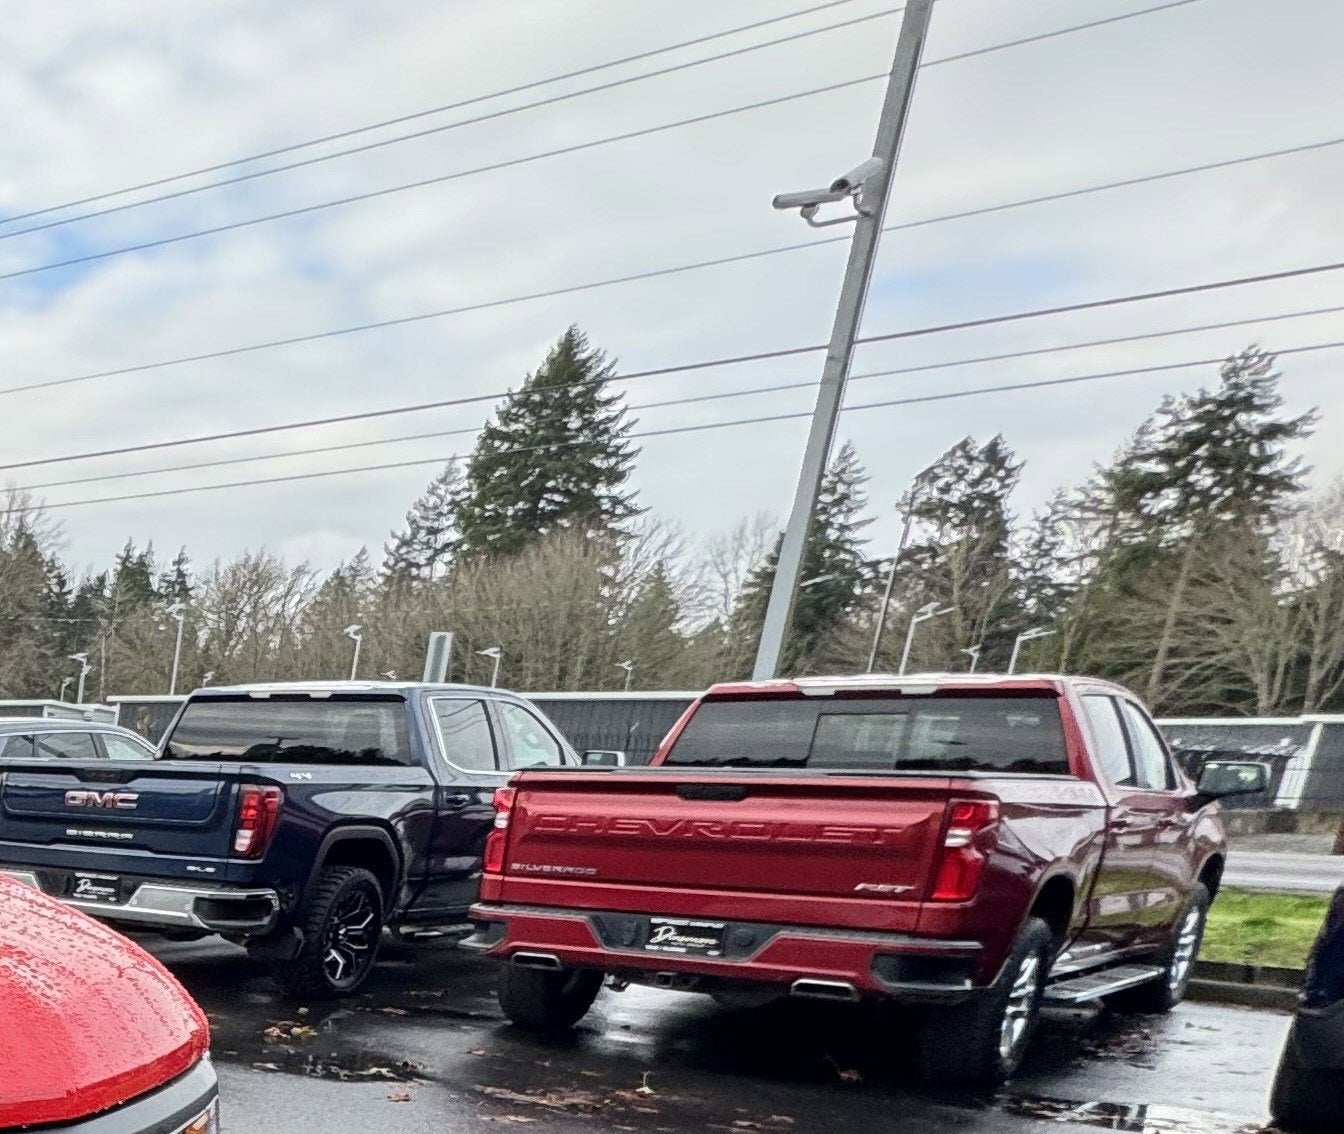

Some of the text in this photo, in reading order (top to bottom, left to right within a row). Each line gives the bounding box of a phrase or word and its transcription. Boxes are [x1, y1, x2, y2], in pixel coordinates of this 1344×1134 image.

[64, 790, 139, 809] GMC
[533, 815, 904, 845] CHEVROLET
[511, 862, 597, 876] SILVERADO
[853, 882, 916, 894] RST
